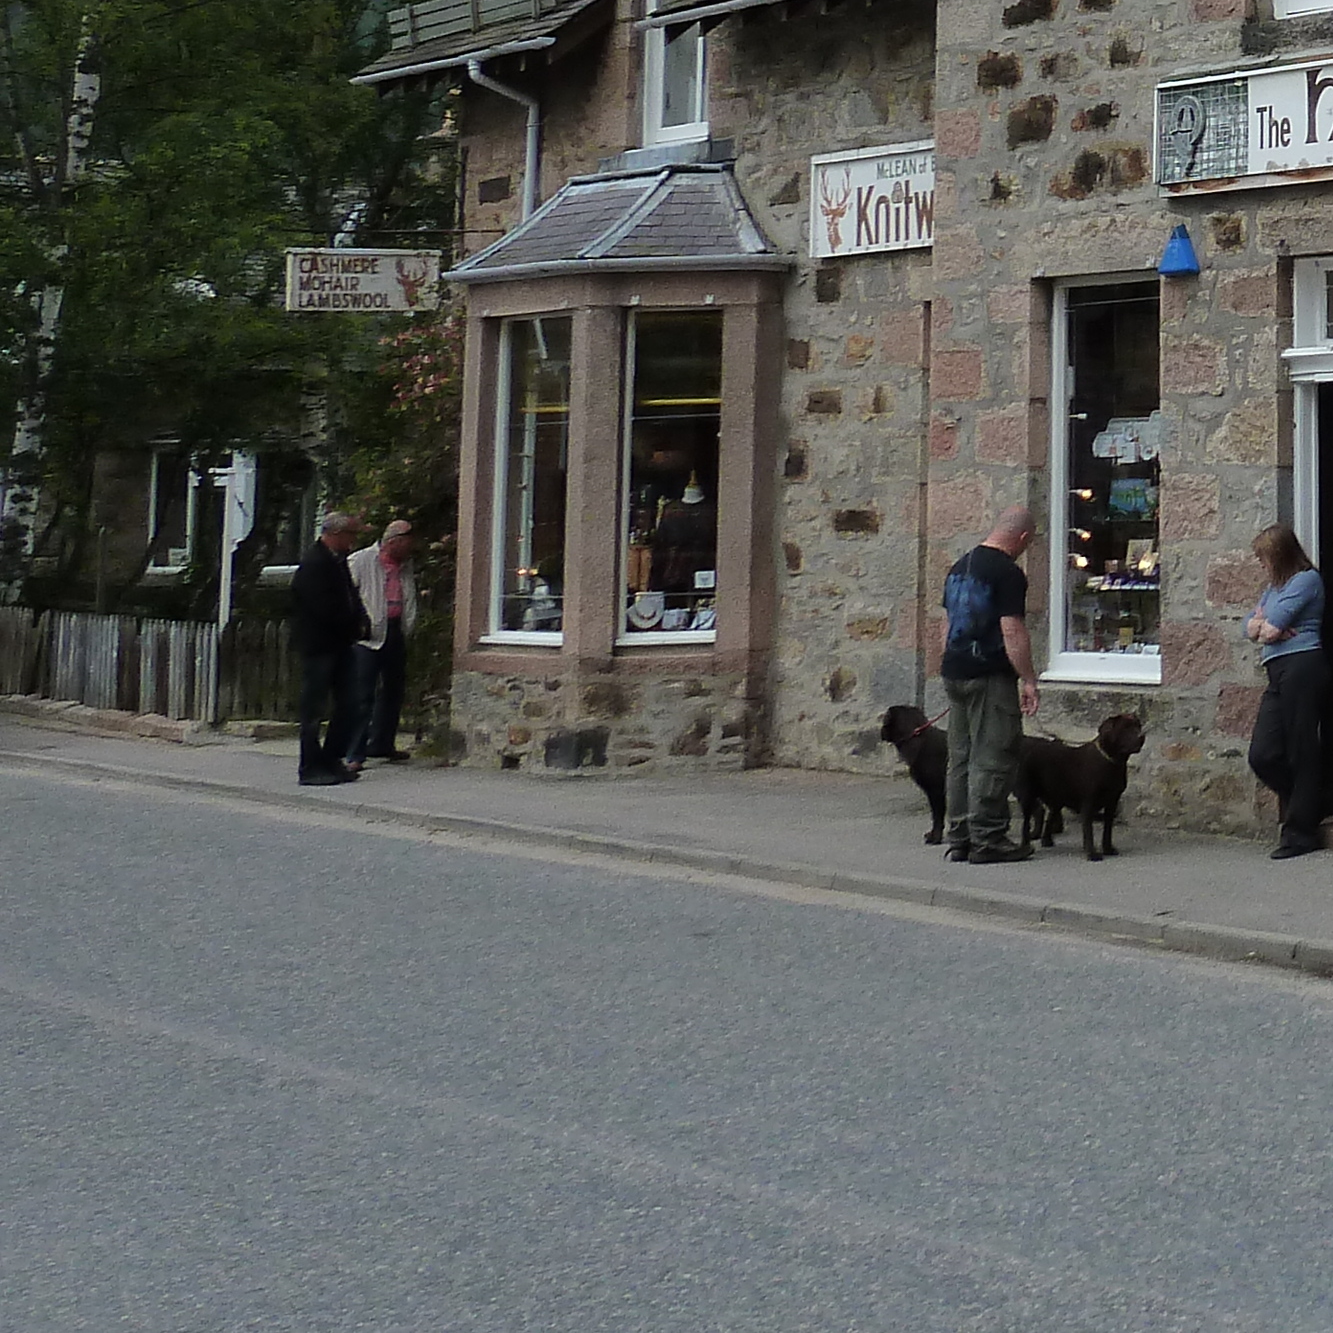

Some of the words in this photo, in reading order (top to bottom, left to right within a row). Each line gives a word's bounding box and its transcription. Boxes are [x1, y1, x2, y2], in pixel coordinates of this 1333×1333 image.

[1256, 106, 1291, 150] The
[300, 256, 380, 274] CASHMERE
[299, 275, 360, 292] MOHAIR
[298, 293, 391, 308] LAMBSWOOL
